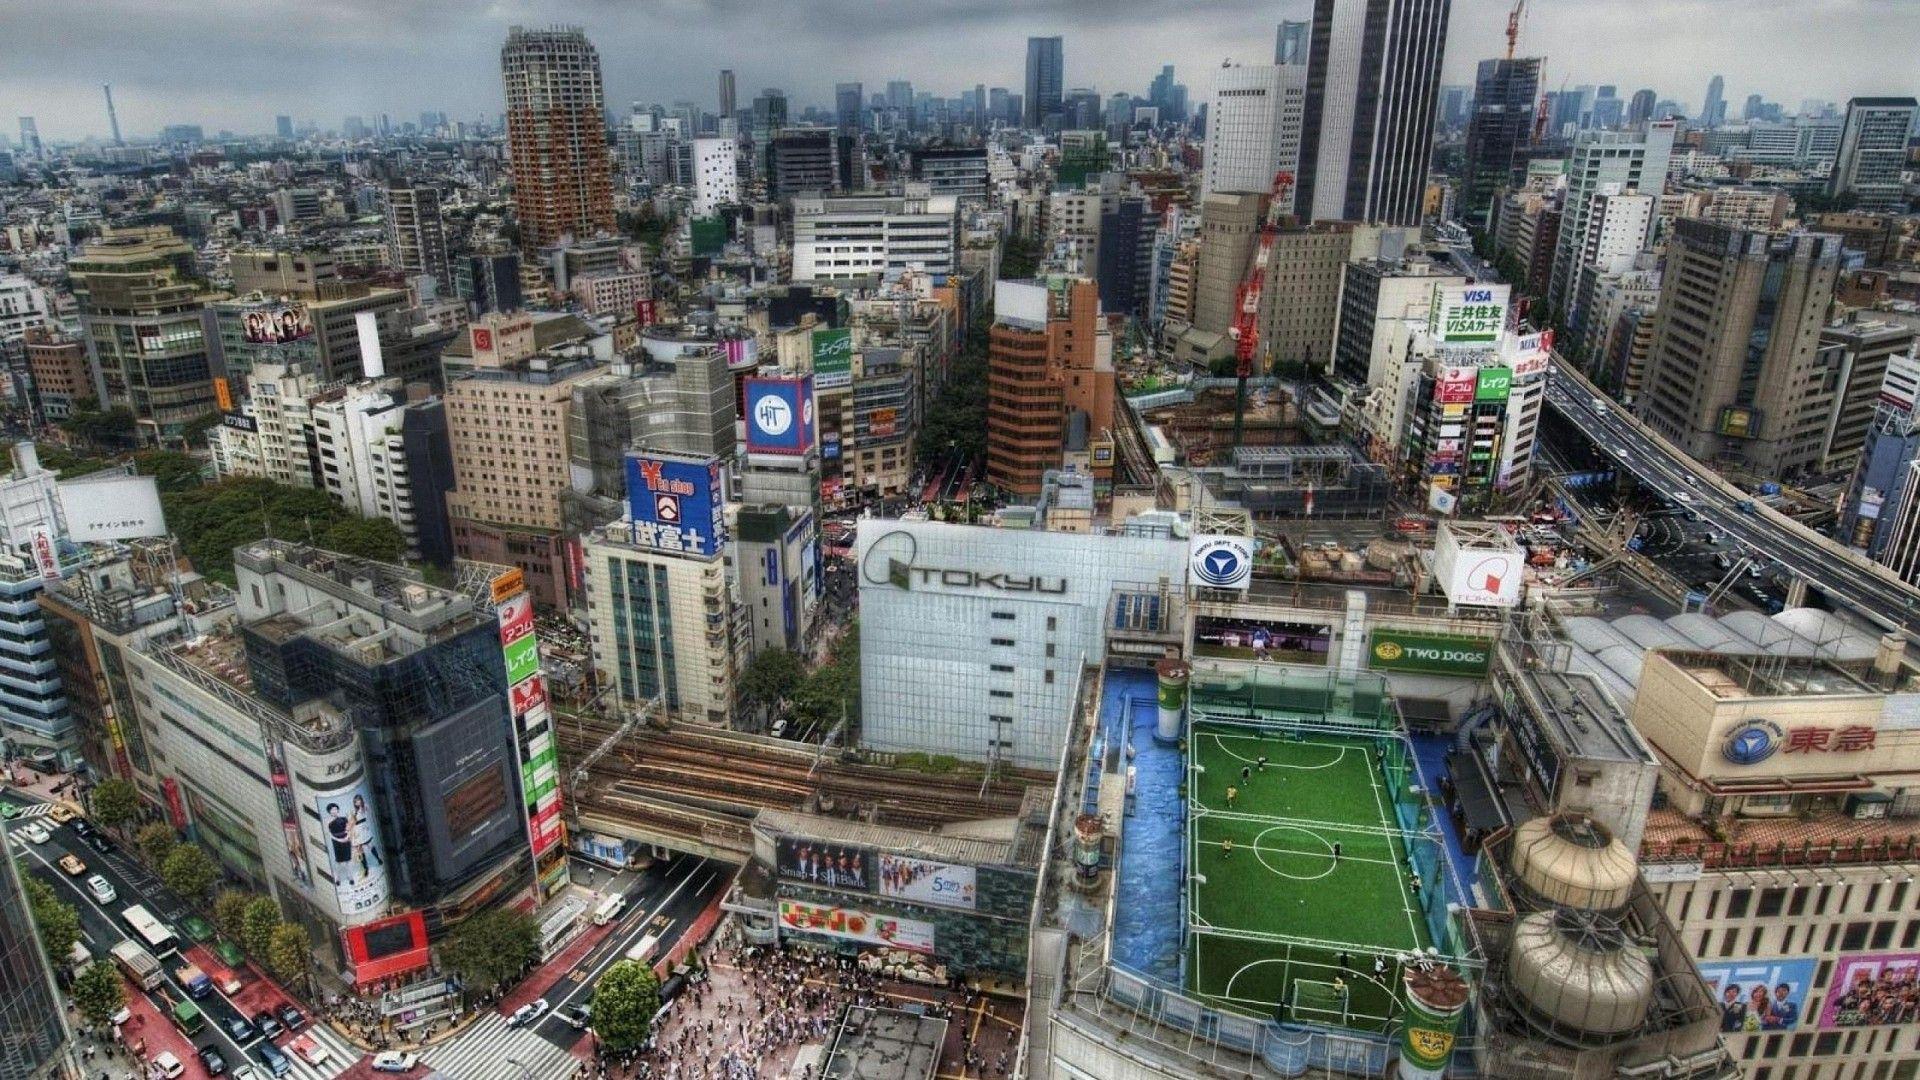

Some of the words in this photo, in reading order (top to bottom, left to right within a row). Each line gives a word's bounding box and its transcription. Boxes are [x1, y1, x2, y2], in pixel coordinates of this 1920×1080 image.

[1464, 290, 1492, 302] VISA
[1447, 304, 1503, 319] 三井住友
[1446, 319, 1501, 332] VISAカード
[1445, 383, 1472, 393] アコム
[1481, 377, 1508, 389] レイク
[634, 519, 706, 554] 武富士
[910, 566, 1067, 595] TOKYU
[504, 620, 534, 643] アコム
[508, 646, 536, 673] レイク
[1403, 647, 1440, 661] TWO
[1440, 650, 1486, 664] DOGS
[1783, 726, 1877, 754] 東急
